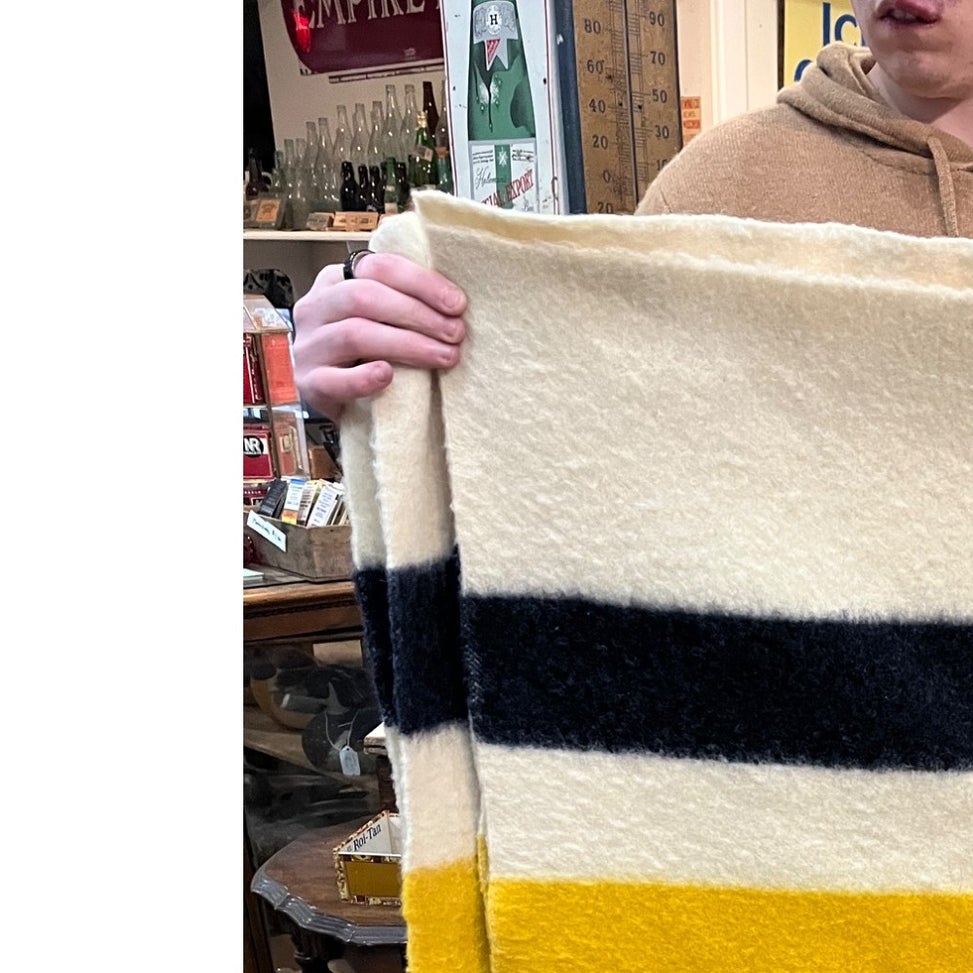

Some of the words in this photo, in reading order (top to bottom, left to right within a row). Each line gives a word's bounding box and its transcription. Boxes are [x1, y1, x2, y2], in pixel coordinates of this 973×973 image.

[490, 14, 498, 25] H
[584, 19, 601, 34] 80
[650, 11, 665, 27] 90
[650, 51, 666, 66] 70
[587, 59, 604, 75] 60
[652, 90, 667, 103] 50
[589, 99, 606, 113] 40
[655, 125, 669, 138] 30
[592, 135, 608, 149] 20
[505, 168, 534, 201] EXPORT
[353, 824, 382, 852] Roi-Tan
